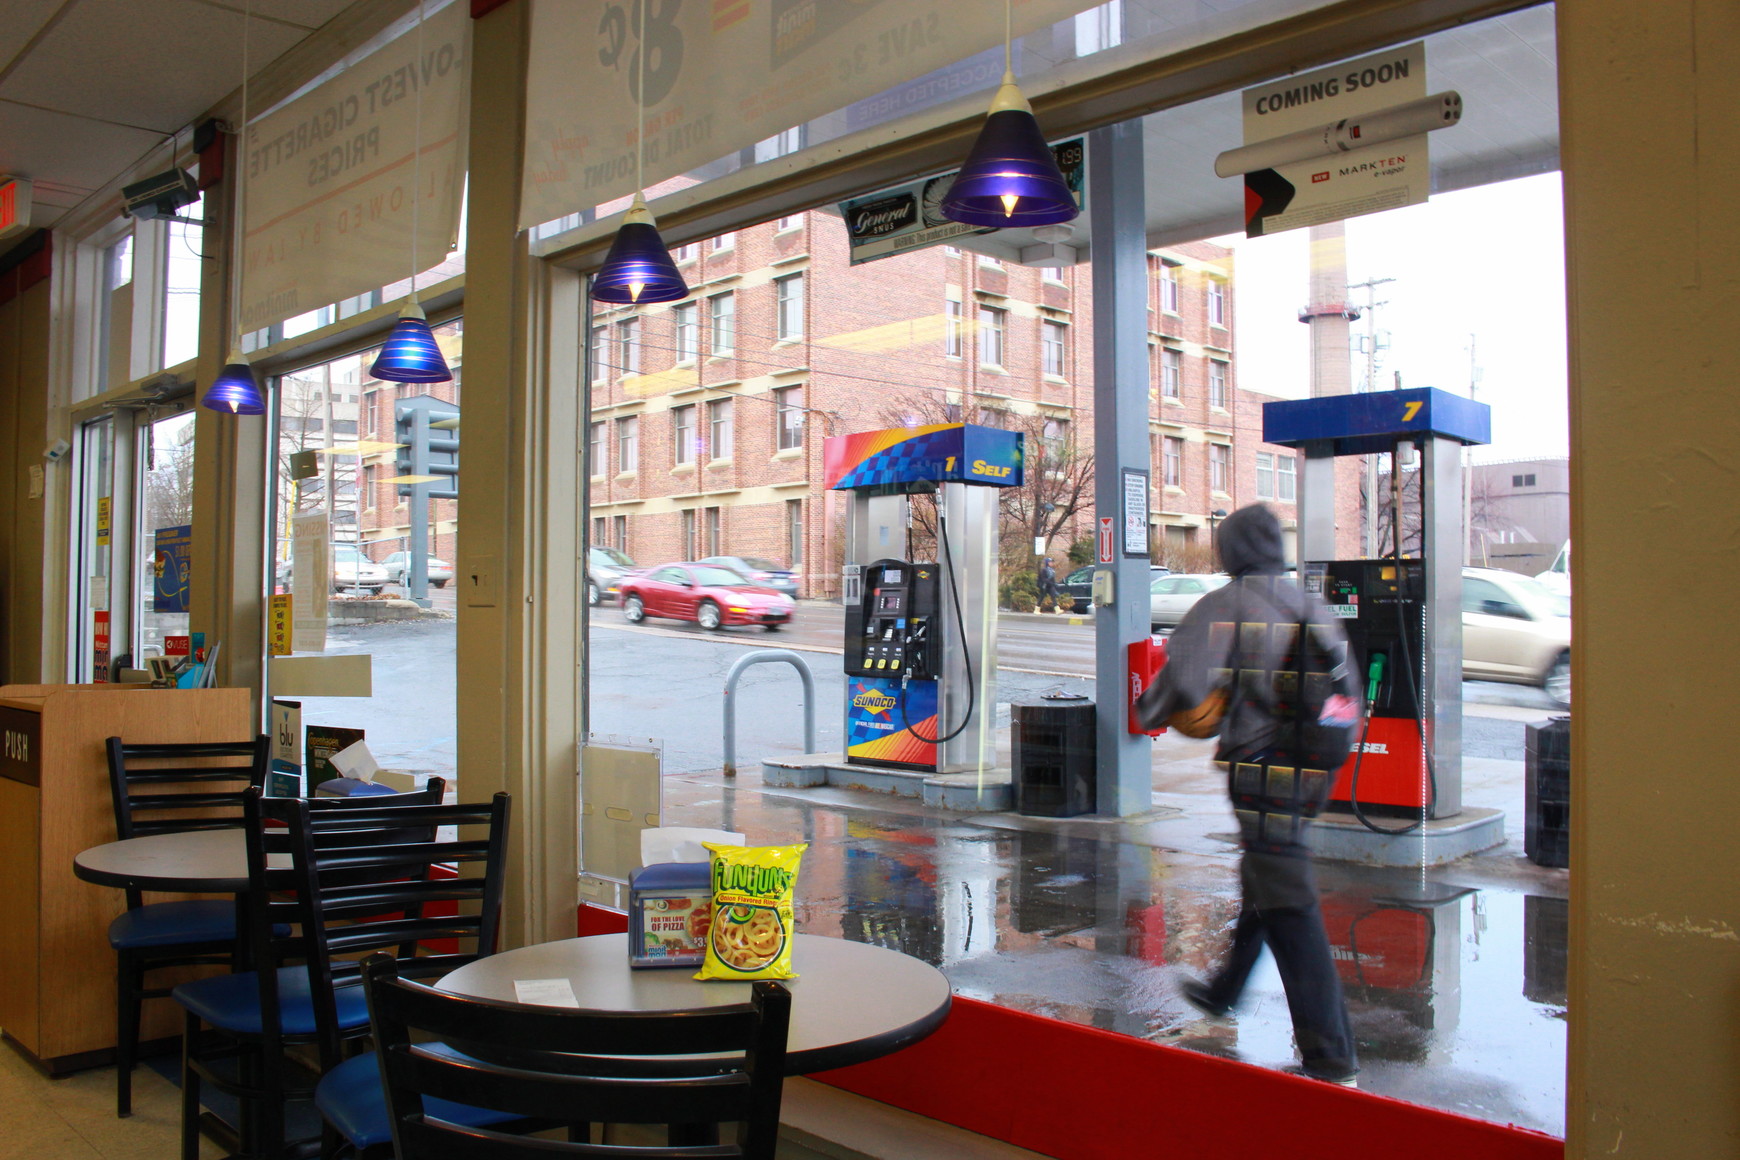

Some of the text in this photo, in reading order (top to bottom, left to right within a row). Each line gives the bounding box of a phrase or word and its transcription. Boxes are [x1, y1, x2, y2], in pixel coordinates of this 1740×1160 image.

[1256, 58, 1409, 115] COMING SOON
[1339, 156, 1406, 176] MARKTEN
[1314, 173, 1328, 182] NEW
[857, 202, 911, 233] General
[873, 222, 895, 234] SNUS
[1401, 401, 1423, 421] 7
[945, 456, 956, 472] 1
[971, 459, 1011, 478] SELF
[855, 696, 894, 708] SUNOCO
[279, 723, 293, 746] blu
[5, 730, 28, 762] PUSH
[1349, 742, 1389, 754] ESEL
[738, 896, 762, 904] Flavored
[652, 922, 684, 931] OF PIZZA
